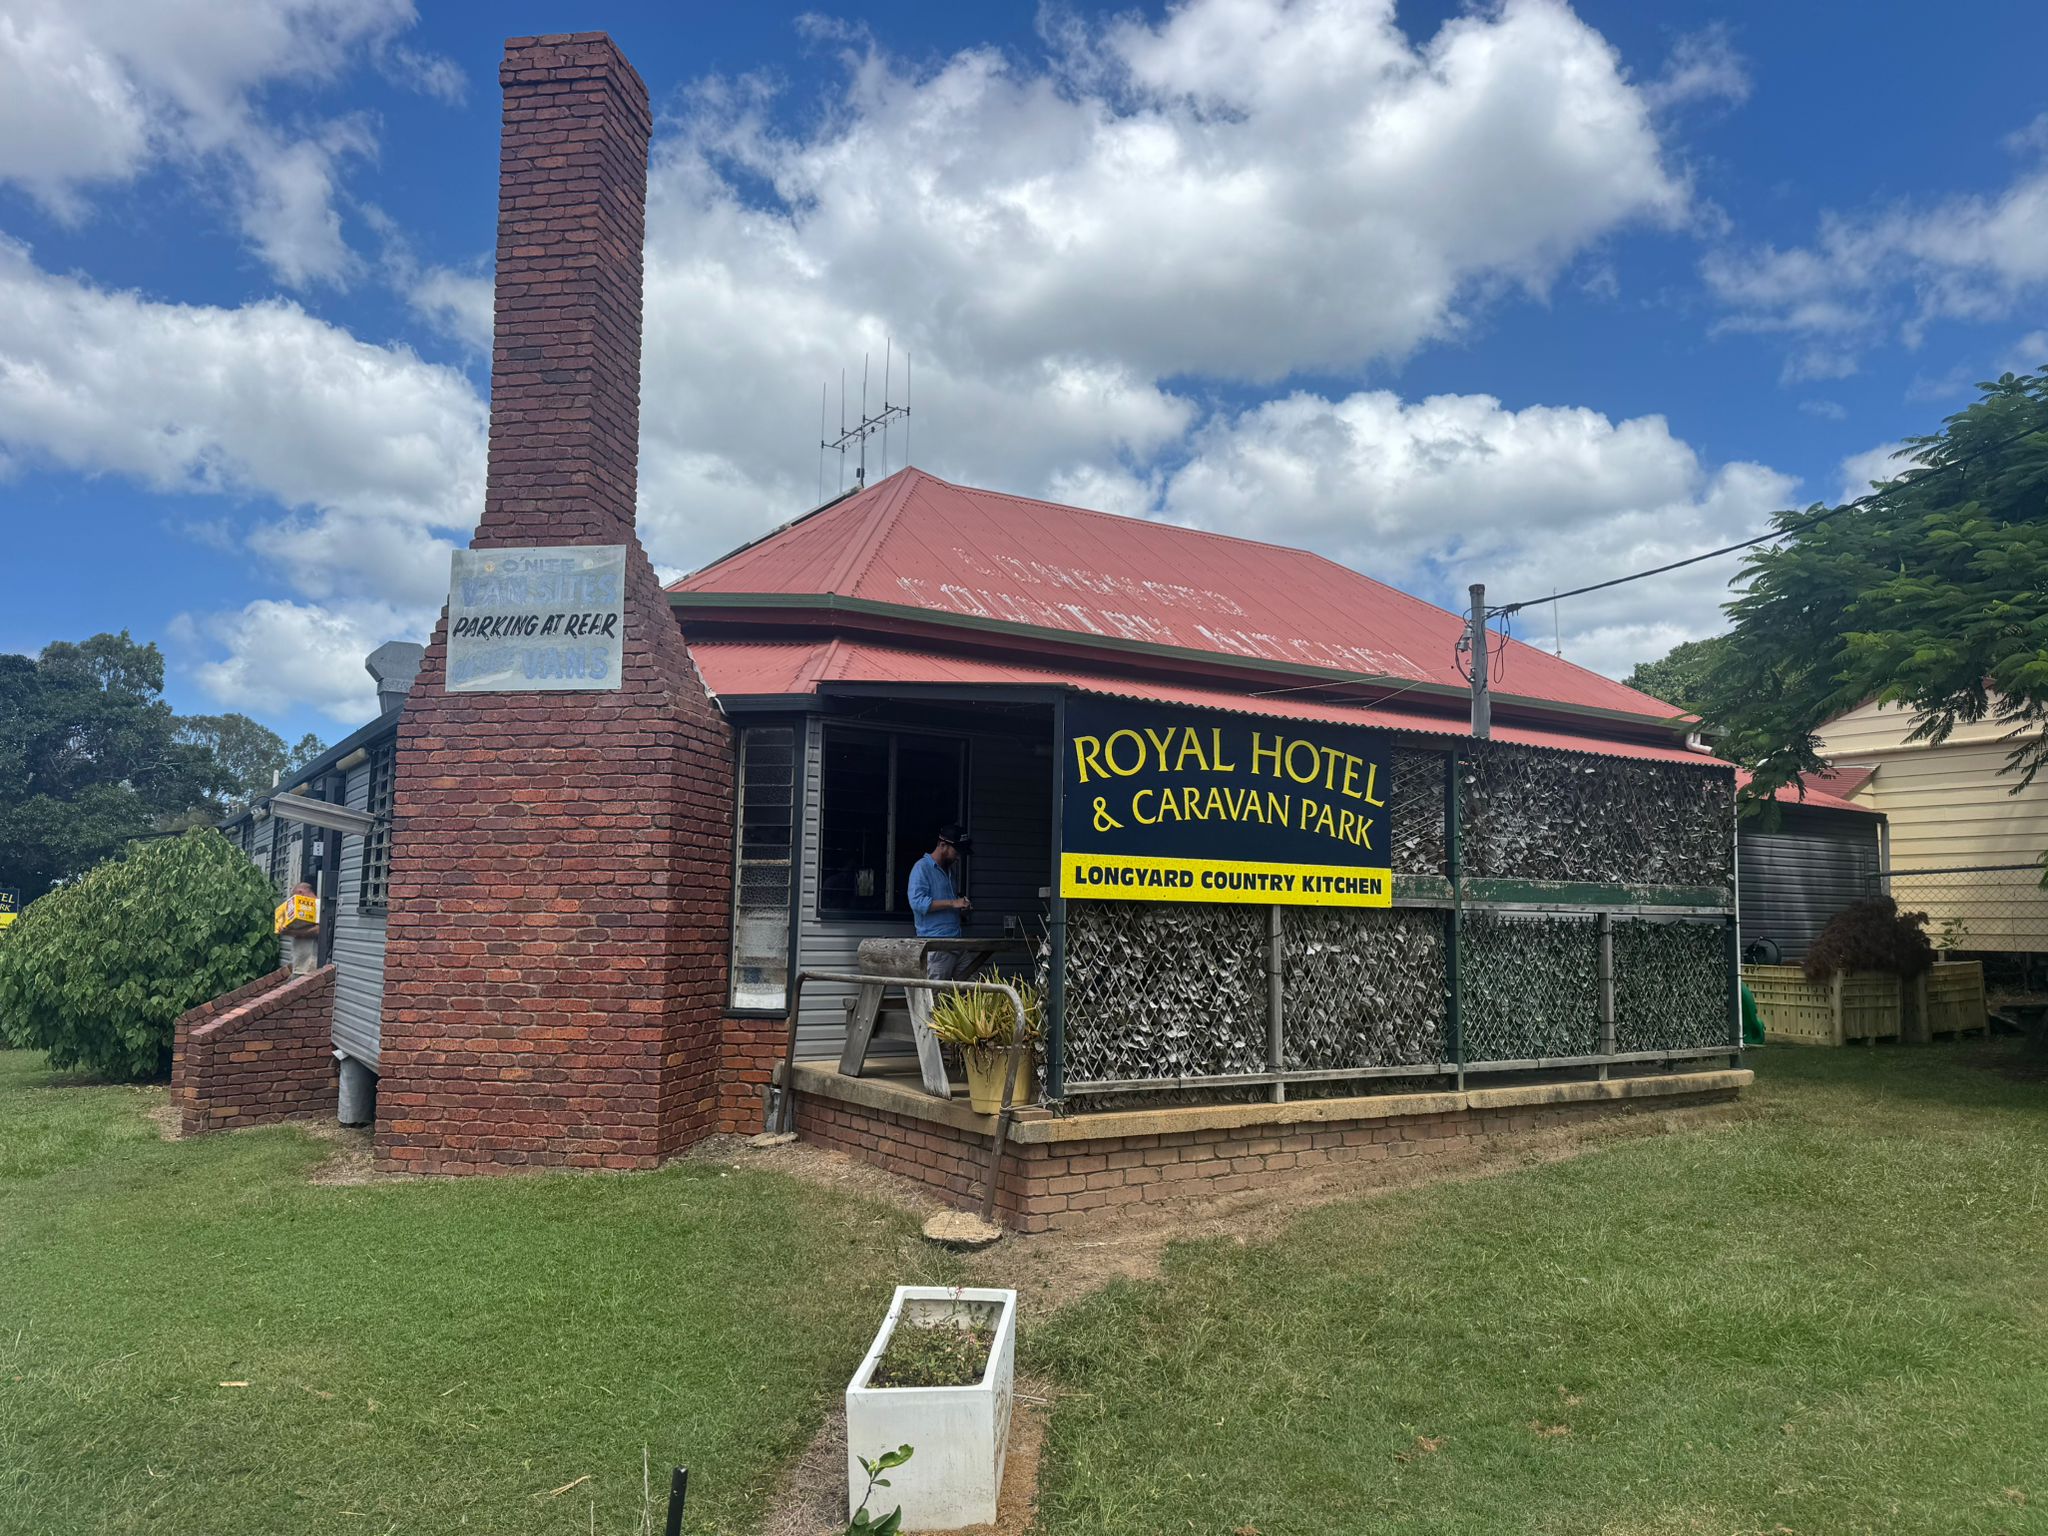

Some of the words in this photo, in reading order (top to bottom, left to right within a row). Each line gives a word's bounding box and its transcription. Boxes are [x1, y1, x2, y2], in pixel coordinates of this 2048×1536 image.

[453, 615, 539, 640] PARKING
[539, 614, 566, 636] AT
[564, 613, 617, 639] REAR
[521, 647, 609, 679] VANS
[1072, 726, 1236, 783] ROYAL
[1250, 731, 1385, 808] HOTEL
[1093, 796, 1125, 832] &
[1132, 787, 1291, 828] CARAVAN
[1299, 798, 1374, 850] PARK
[1075, 865, 1194, 888] LONGYARD
[1201, 871, 1296, 892] COUNTRY
[1302, 875, 1382, 895] KITCHEN
